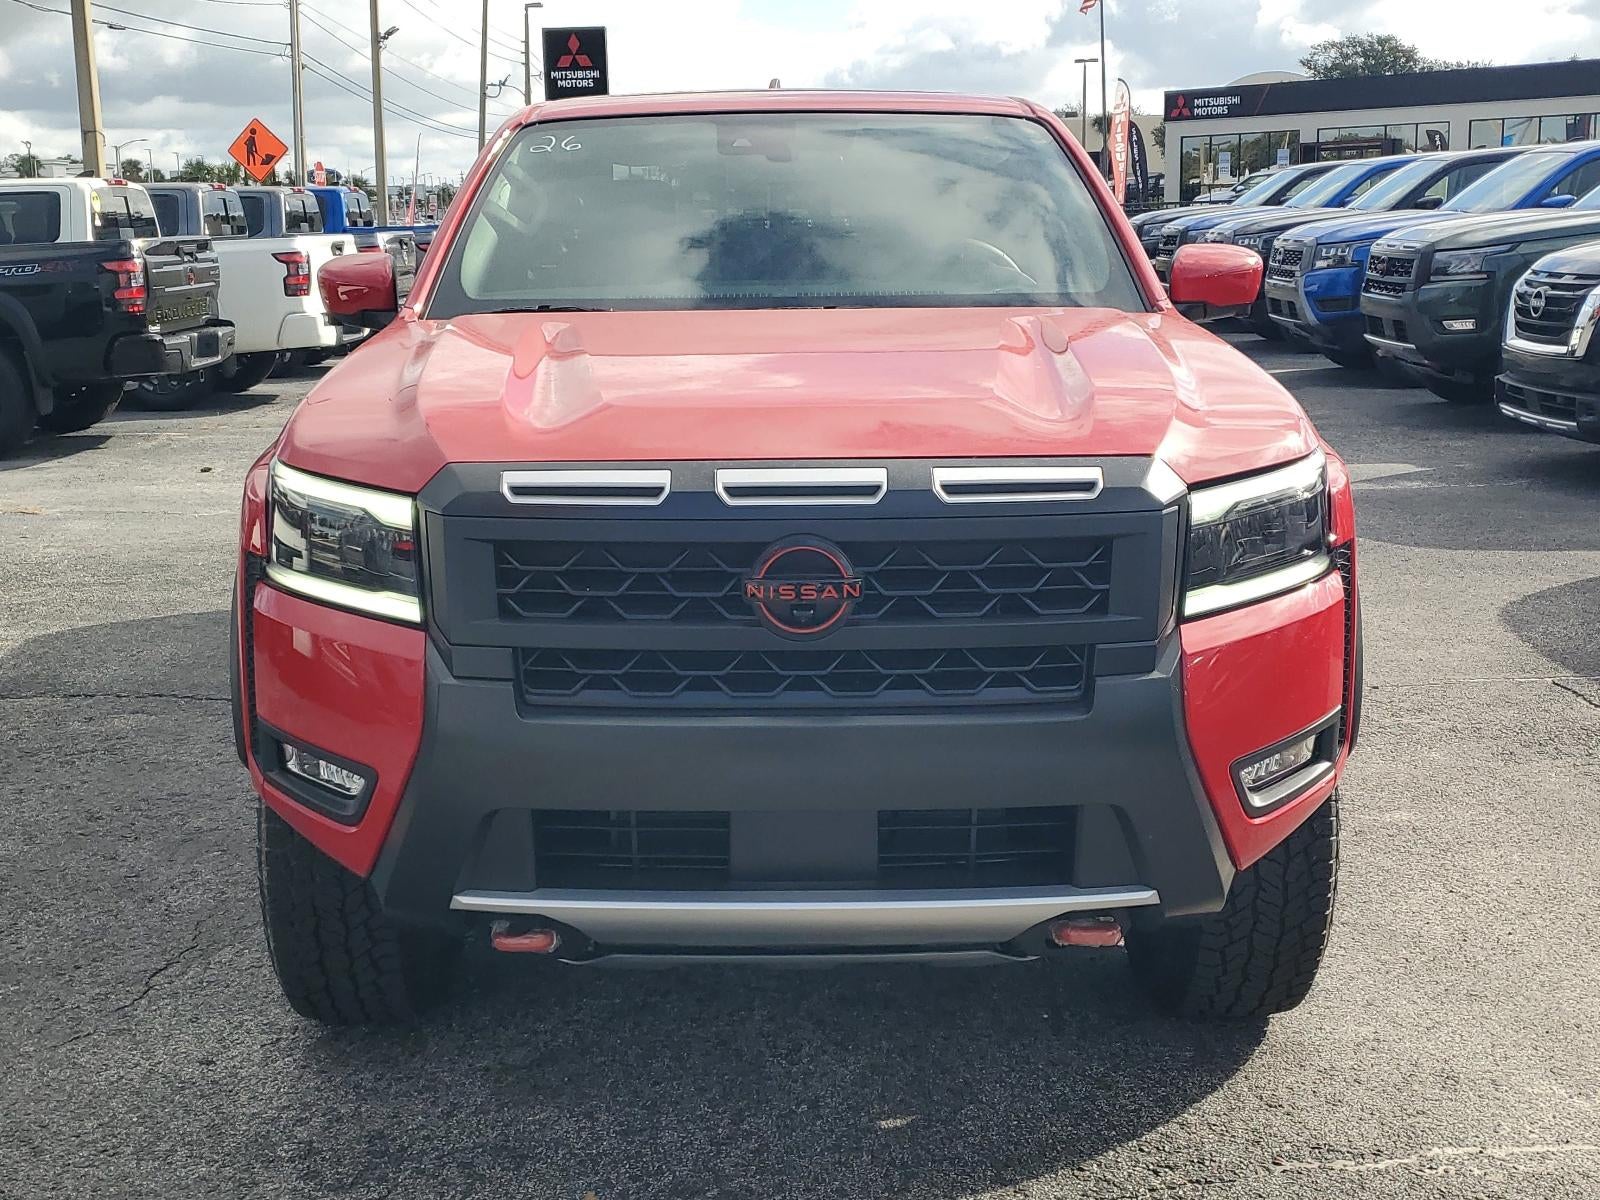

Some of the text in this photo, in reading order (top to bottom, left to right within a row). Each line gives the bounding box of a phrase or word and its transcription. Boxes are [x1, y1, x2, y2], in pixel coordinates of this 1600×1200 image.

[551, 70, 600, 80] MITSUBISHI
[557, 79, 594, 88] MOTORS
[1194, 95, 1241, 107] MITSUBISHI
[1194, 106, 1229, 117] MOTORS
[529, 135, 582, 153] 26
[1131, 127, 1140, 161] SALES
[746, 583, 861, 600] NISSAN
